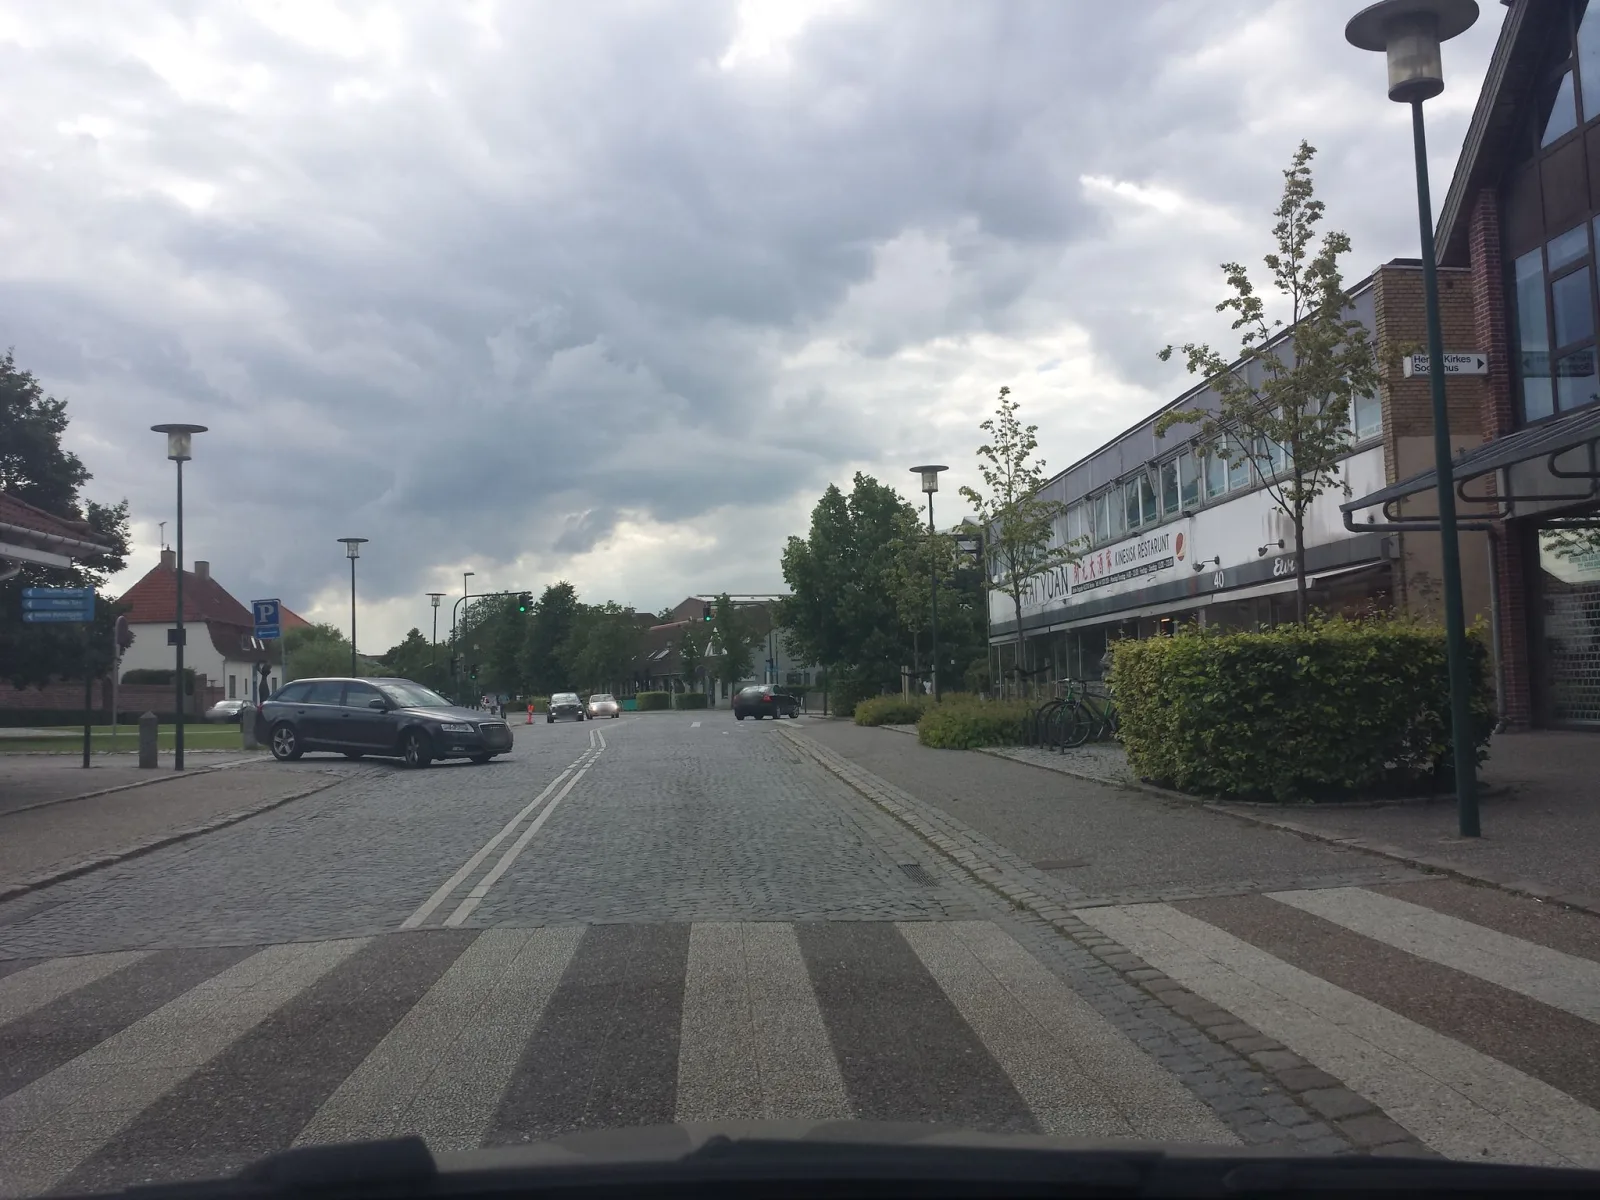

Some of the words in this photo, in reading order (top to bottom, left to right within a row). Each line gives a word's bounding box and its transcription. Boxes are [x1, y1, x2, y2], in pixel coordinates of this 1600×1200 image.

[1444, 355, 1471, 363] Kirkes
[1114, 545, 1137, 566] KINESISK
[1040, 566, 1069, 600] YUAN
[1213, 571, 1225, 588] 40
[259, 604, 275, 623] P
